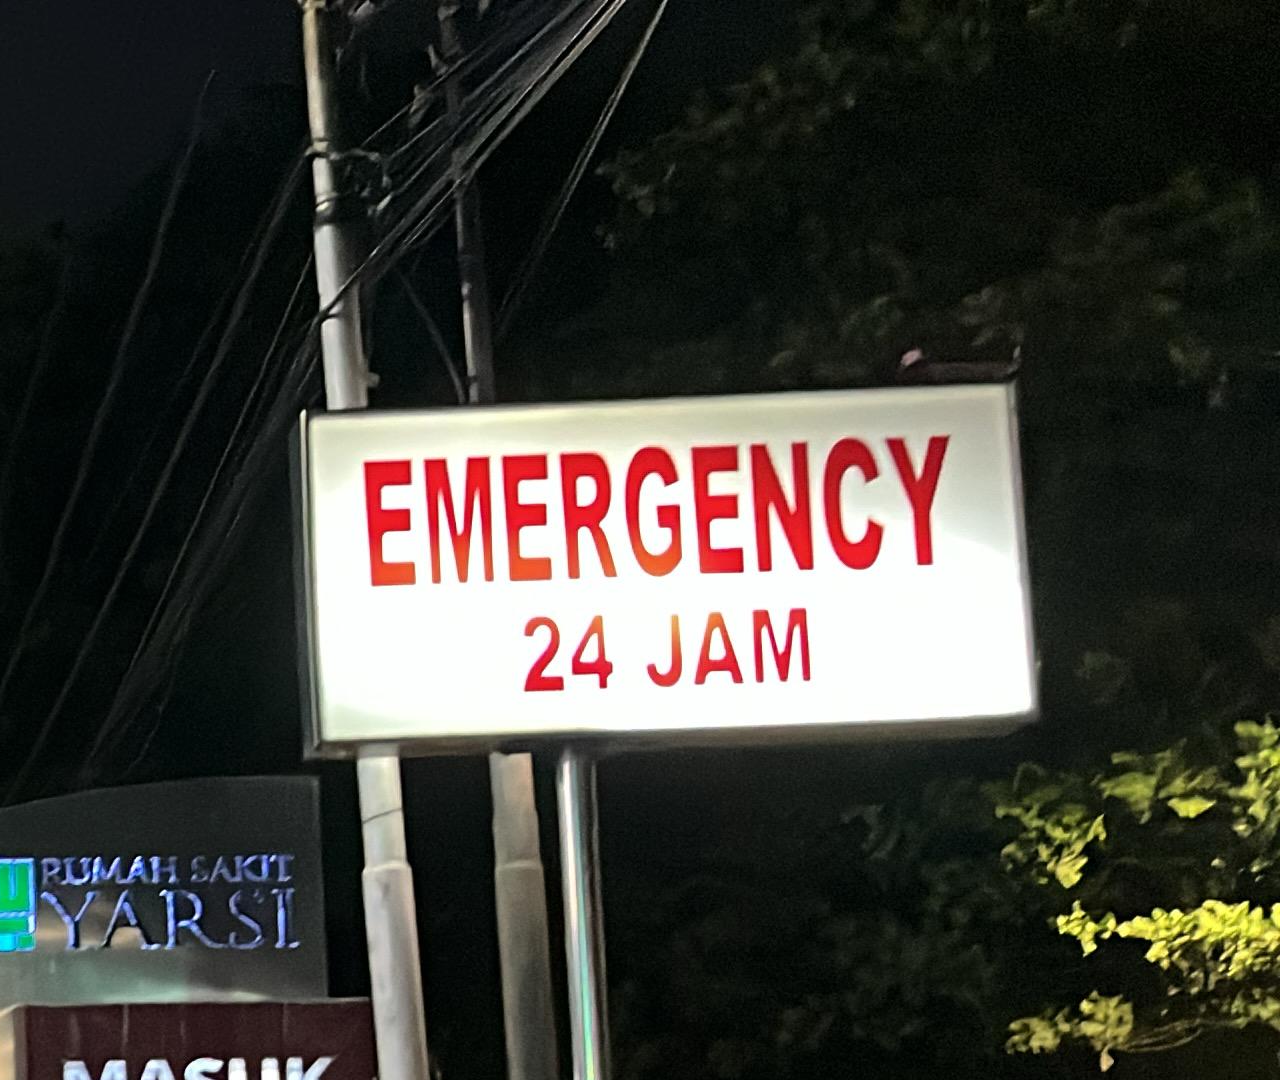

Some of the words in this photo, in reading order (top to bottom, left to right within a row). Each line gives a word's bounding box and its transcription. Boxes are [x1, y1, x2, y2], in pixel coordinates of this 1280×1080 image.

[364, 435, 951, 586] EMERGENCY
[524, 615, 613, 692] 24
[647, 608, 811, 688] JAM
[41, 856, 179, 886] RUMAH
[190, 854, 296, 884] SAKIT
[41, 887, 301, 951] YARSI
